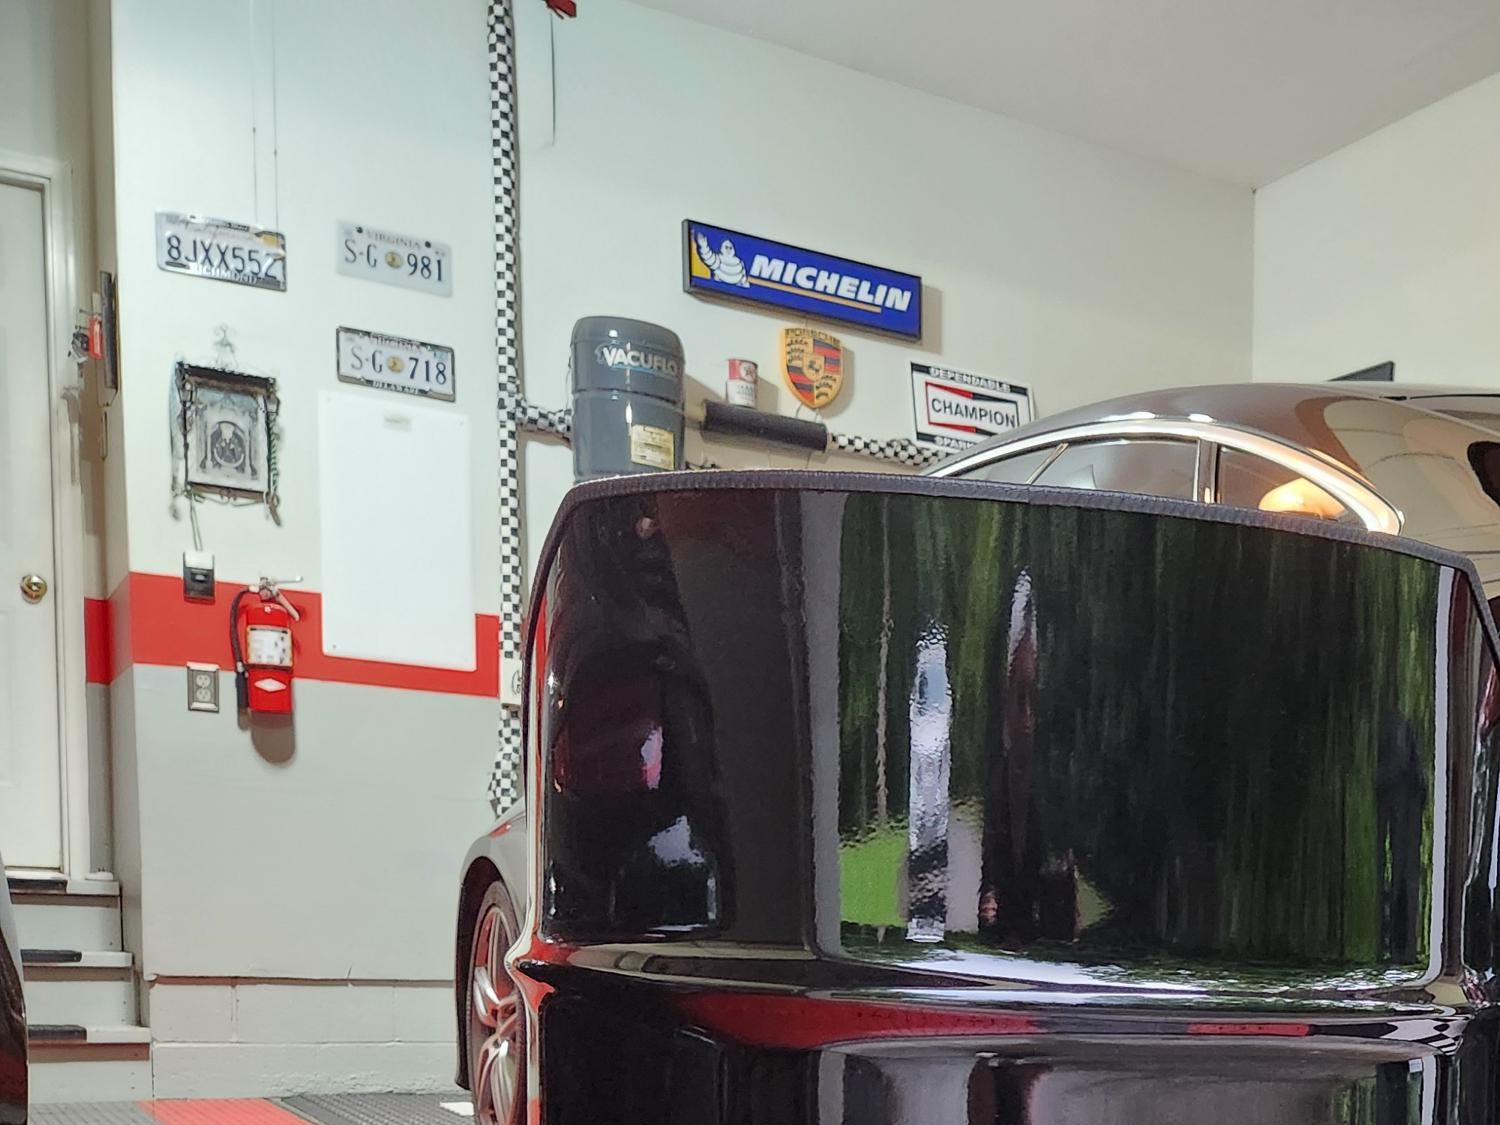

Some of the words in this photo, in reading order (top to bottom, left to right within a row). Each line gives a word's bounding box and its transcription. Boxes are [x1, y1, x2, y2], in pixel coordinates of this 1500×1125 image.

[406, 252, 443, 282] 981
[750, 253, 912, 312] MICHELIN
[408, 356, 447, 386] 718
[602, 346, 678, 374] VACUFLO
[929, 365, 1012, 394] DEPENDABLE
[931, 398, 1016, 429] CHAMPION
